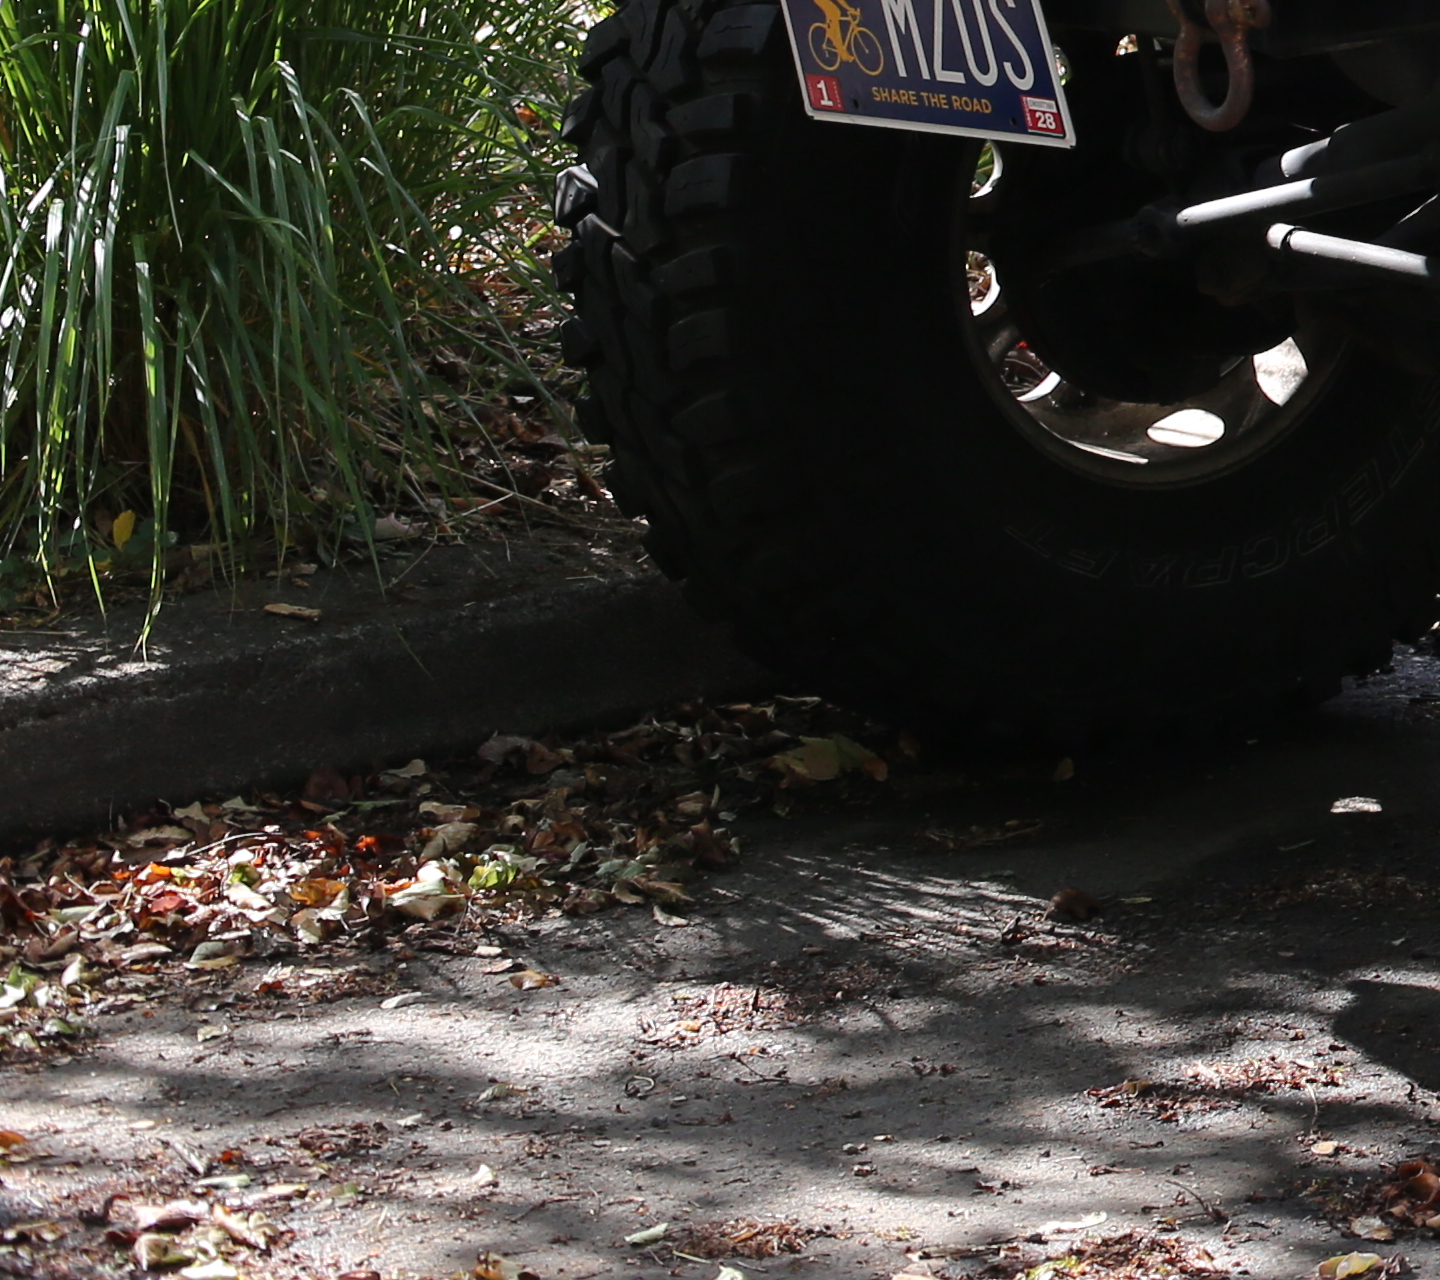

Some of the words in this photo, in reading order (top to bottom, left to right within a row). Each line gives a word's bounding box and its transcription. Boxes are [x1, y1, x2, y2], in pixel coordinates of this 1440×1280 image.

[816, 79, 834, 107] 1
[871, 86, 918, 106] SHARE
[920, 91, 949, 109] THE
[950, 95, 992, 114] ROAD
[1035, 111, 1056, 130] 28
